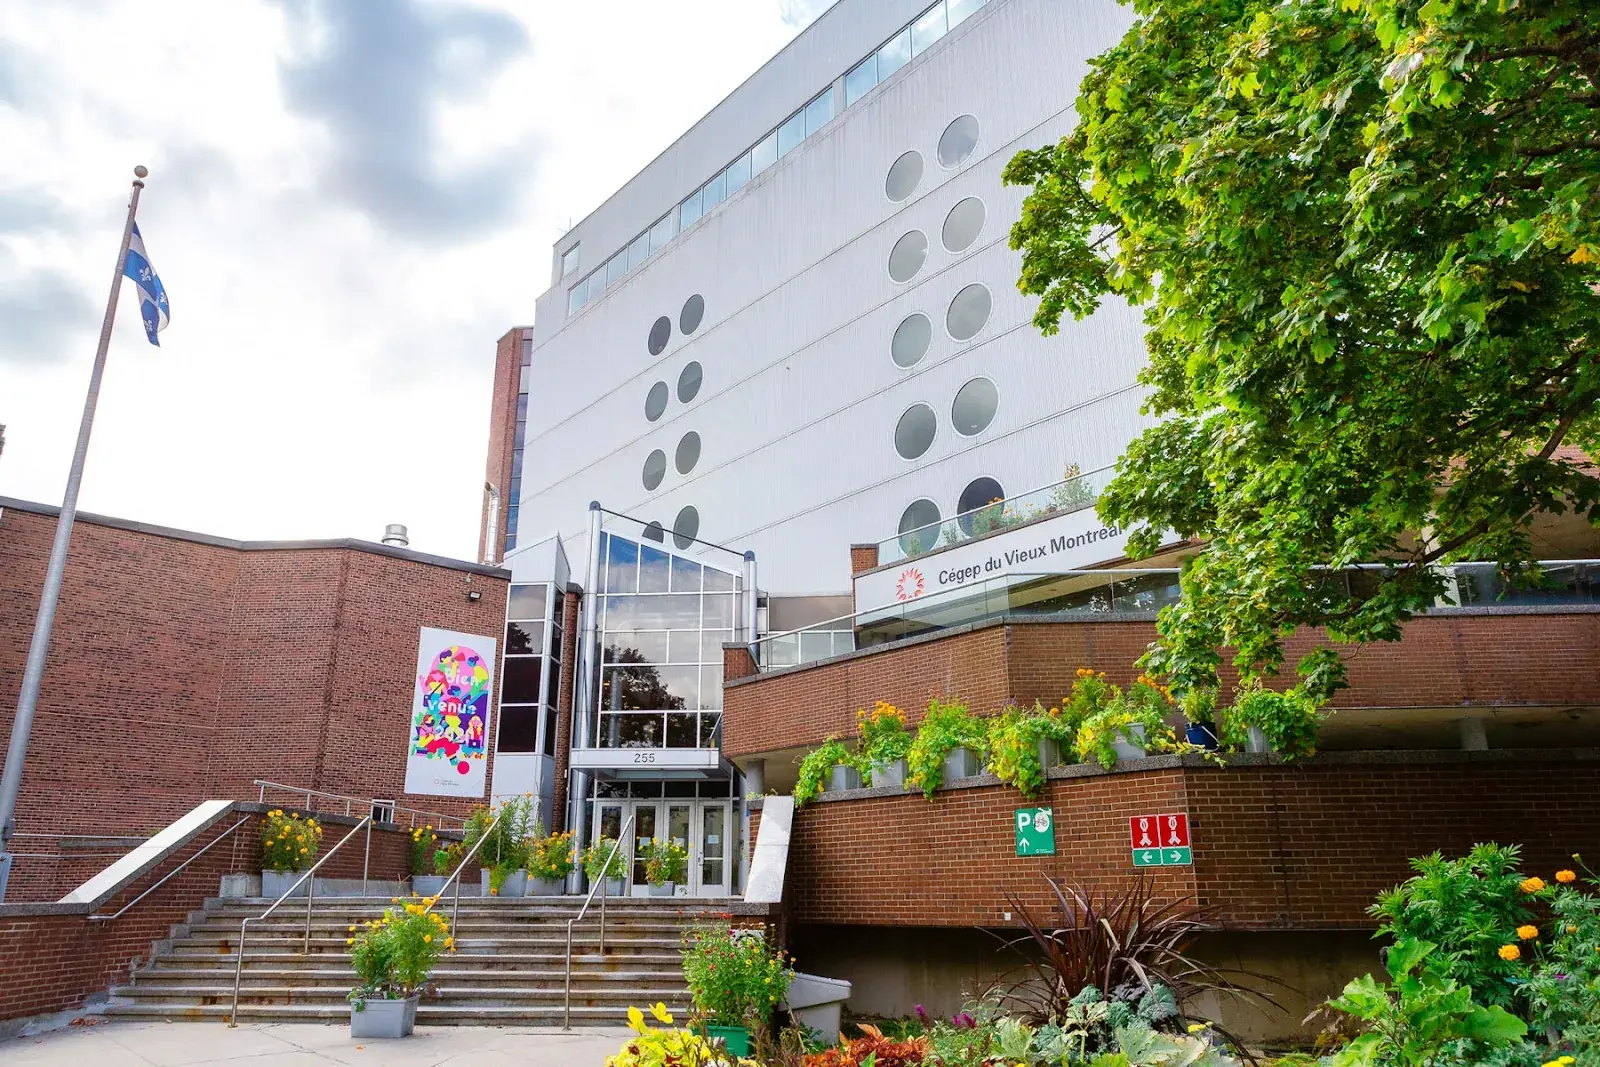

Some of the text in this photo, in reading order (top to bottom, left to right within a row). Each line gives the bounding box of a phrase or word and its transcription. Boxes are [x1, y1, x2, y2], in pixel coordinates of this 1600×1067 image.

[939, 565, 981, 585] Cégep
[985, 555, 1002, 571] du
[1004, 545, 1046, 566] Vieux
[427, 700, 477, 715] venue
[634, 753, 655, 763] 255
[1017, 813, 1031, 833] P
